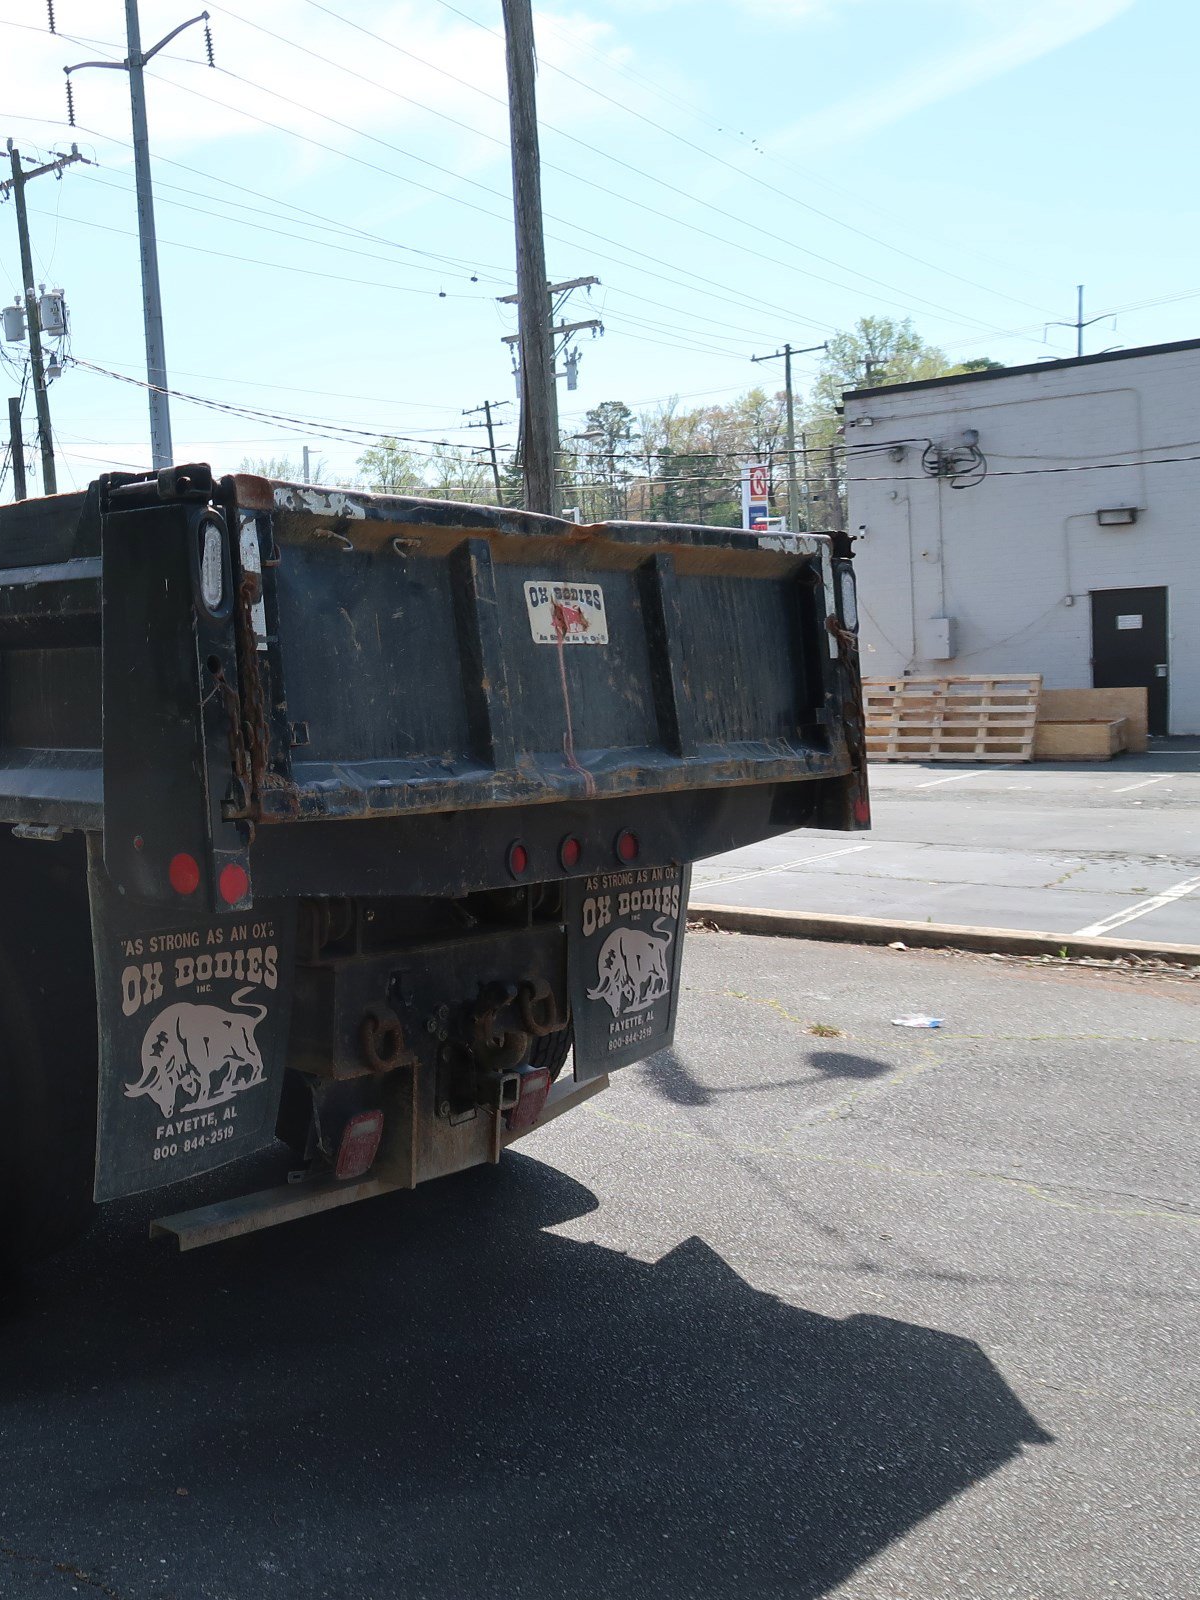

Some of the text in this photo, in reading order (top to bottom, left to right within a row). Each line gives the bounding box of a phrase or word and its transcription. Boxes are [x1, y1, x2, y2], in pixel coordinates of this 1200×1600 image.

[529, 586, 602, 611] OX BODIES
[602, 872, 633, 889] STRONG
[636, 870, 648, 883] AS
[652, 869, 663, 881] AN
[582, 885, 680, 937] OX BODIES
[150, 932, 200, 953] STRONG
[206, 927, 224, 945] AS
[230, 924, 247, 942] AN
[121, 945, 279, 1017] OX BODIES
[609, 1010, 655, 1034] FAYETTE, AL
[156, 1105, 238, 1140] FAYETTE, AL
[153, 1125, 235, 1161] 800 844-2519
